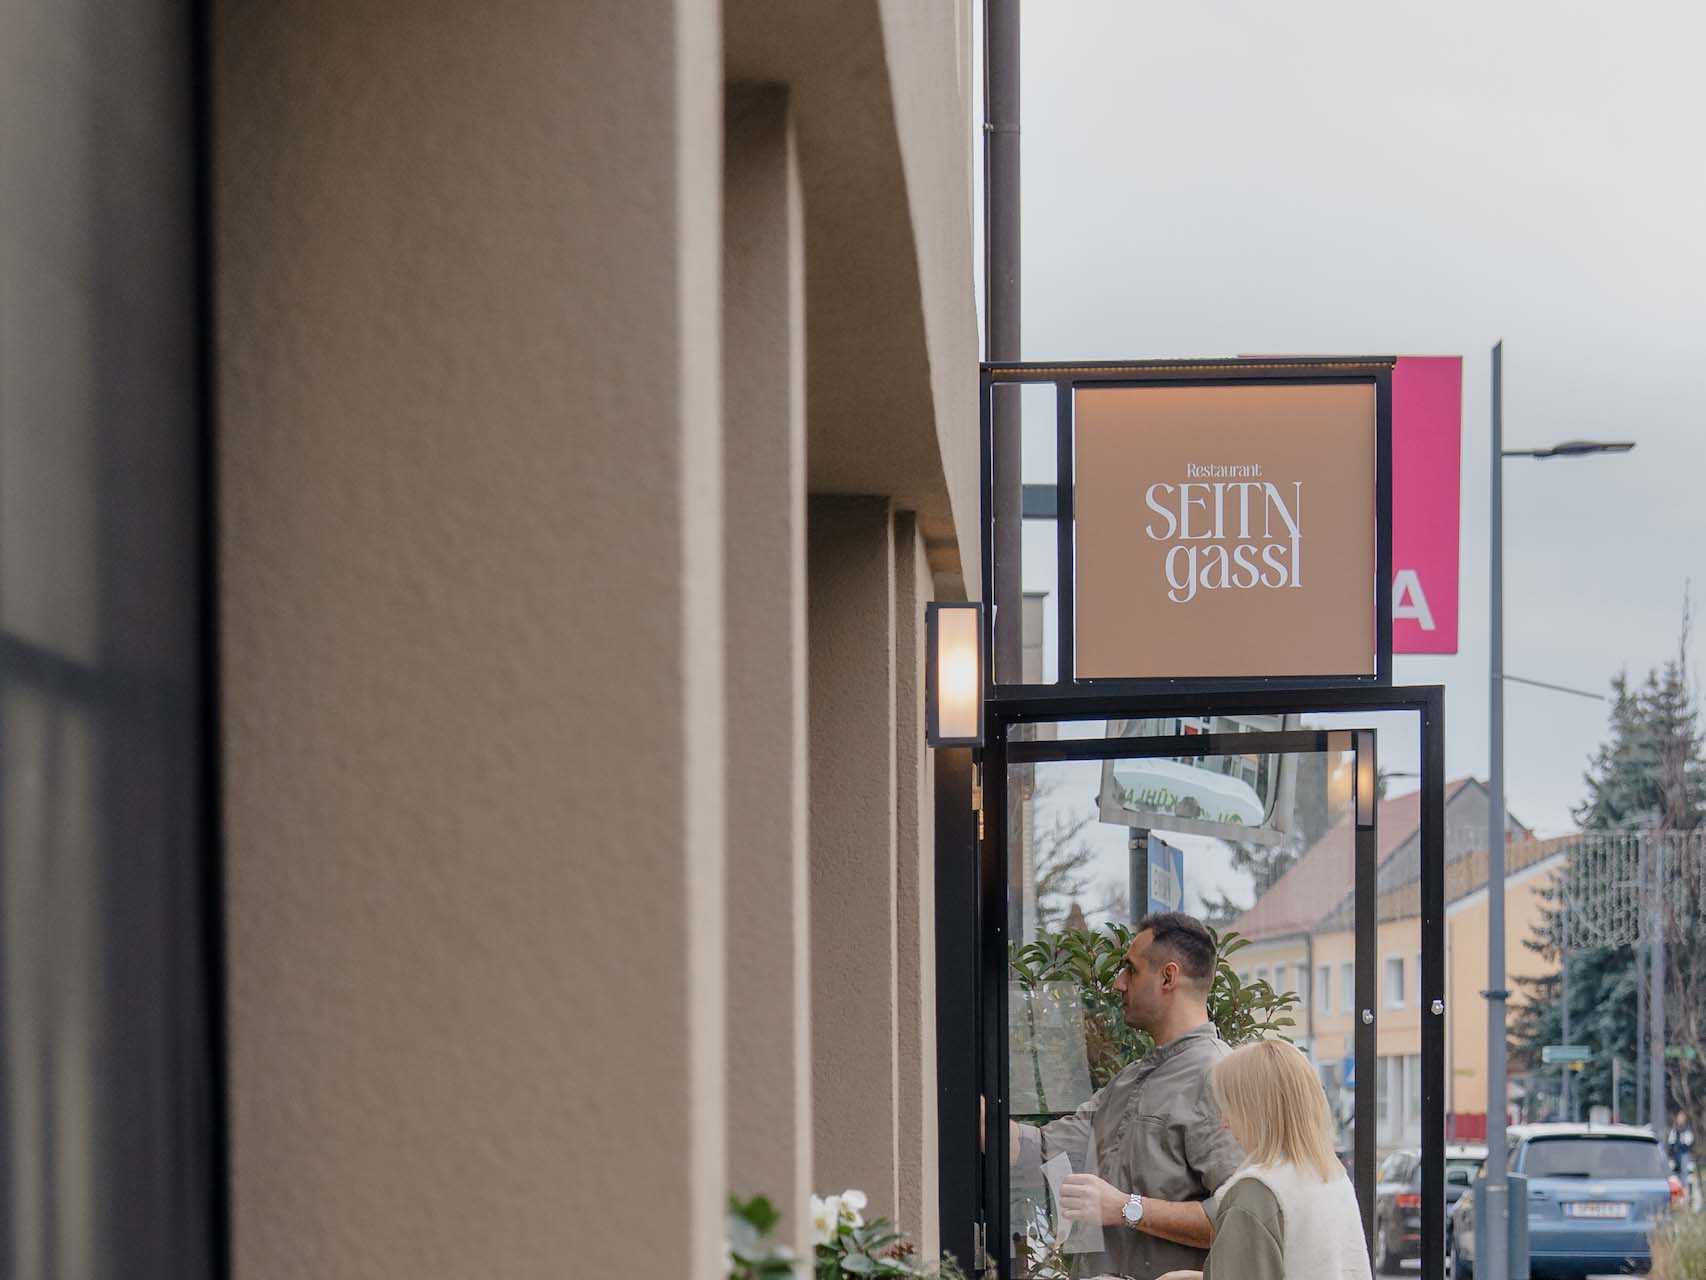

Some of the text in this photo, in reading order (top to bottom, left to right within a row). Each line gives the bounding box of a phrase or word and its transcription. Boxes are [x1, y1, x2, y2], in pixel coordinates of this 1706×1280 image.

[1186, 463, 1263, 478] Restaurant
[1144, 481, 1303, 541] SEITN
[1165, 541, 1303, 604] gassl
